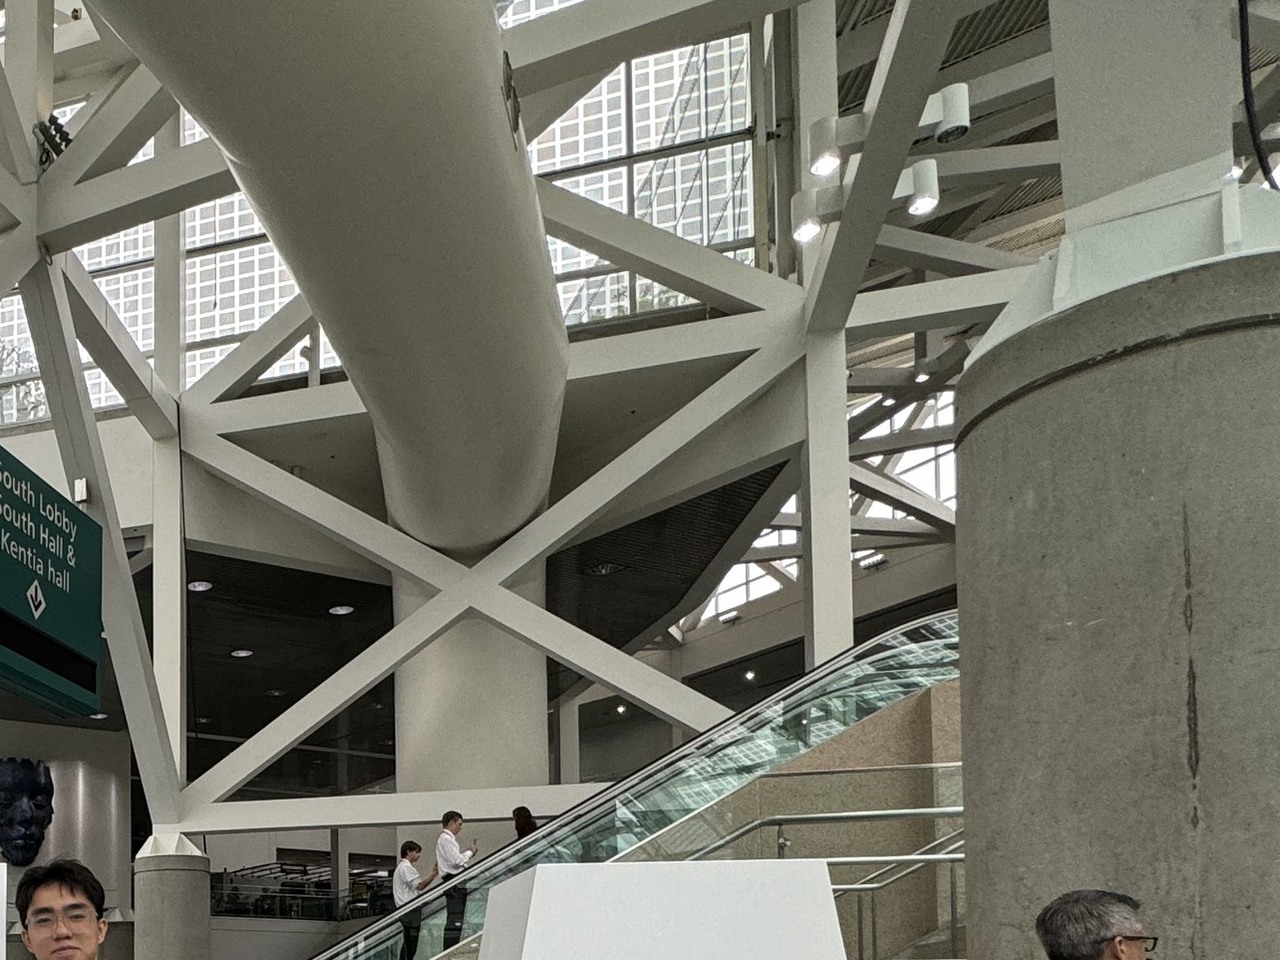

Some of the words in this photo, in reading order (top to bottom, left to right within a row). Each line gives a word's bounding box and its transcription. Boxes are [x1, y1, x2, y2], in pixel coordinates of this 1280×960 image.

[39, 493, 78, 542] Lobby
[0, 528, 44, 576] Kentia
[48, 559, 70, 593] hall
[39, 524, 64, 560] Hall
[66, 545, 76, 567] &
